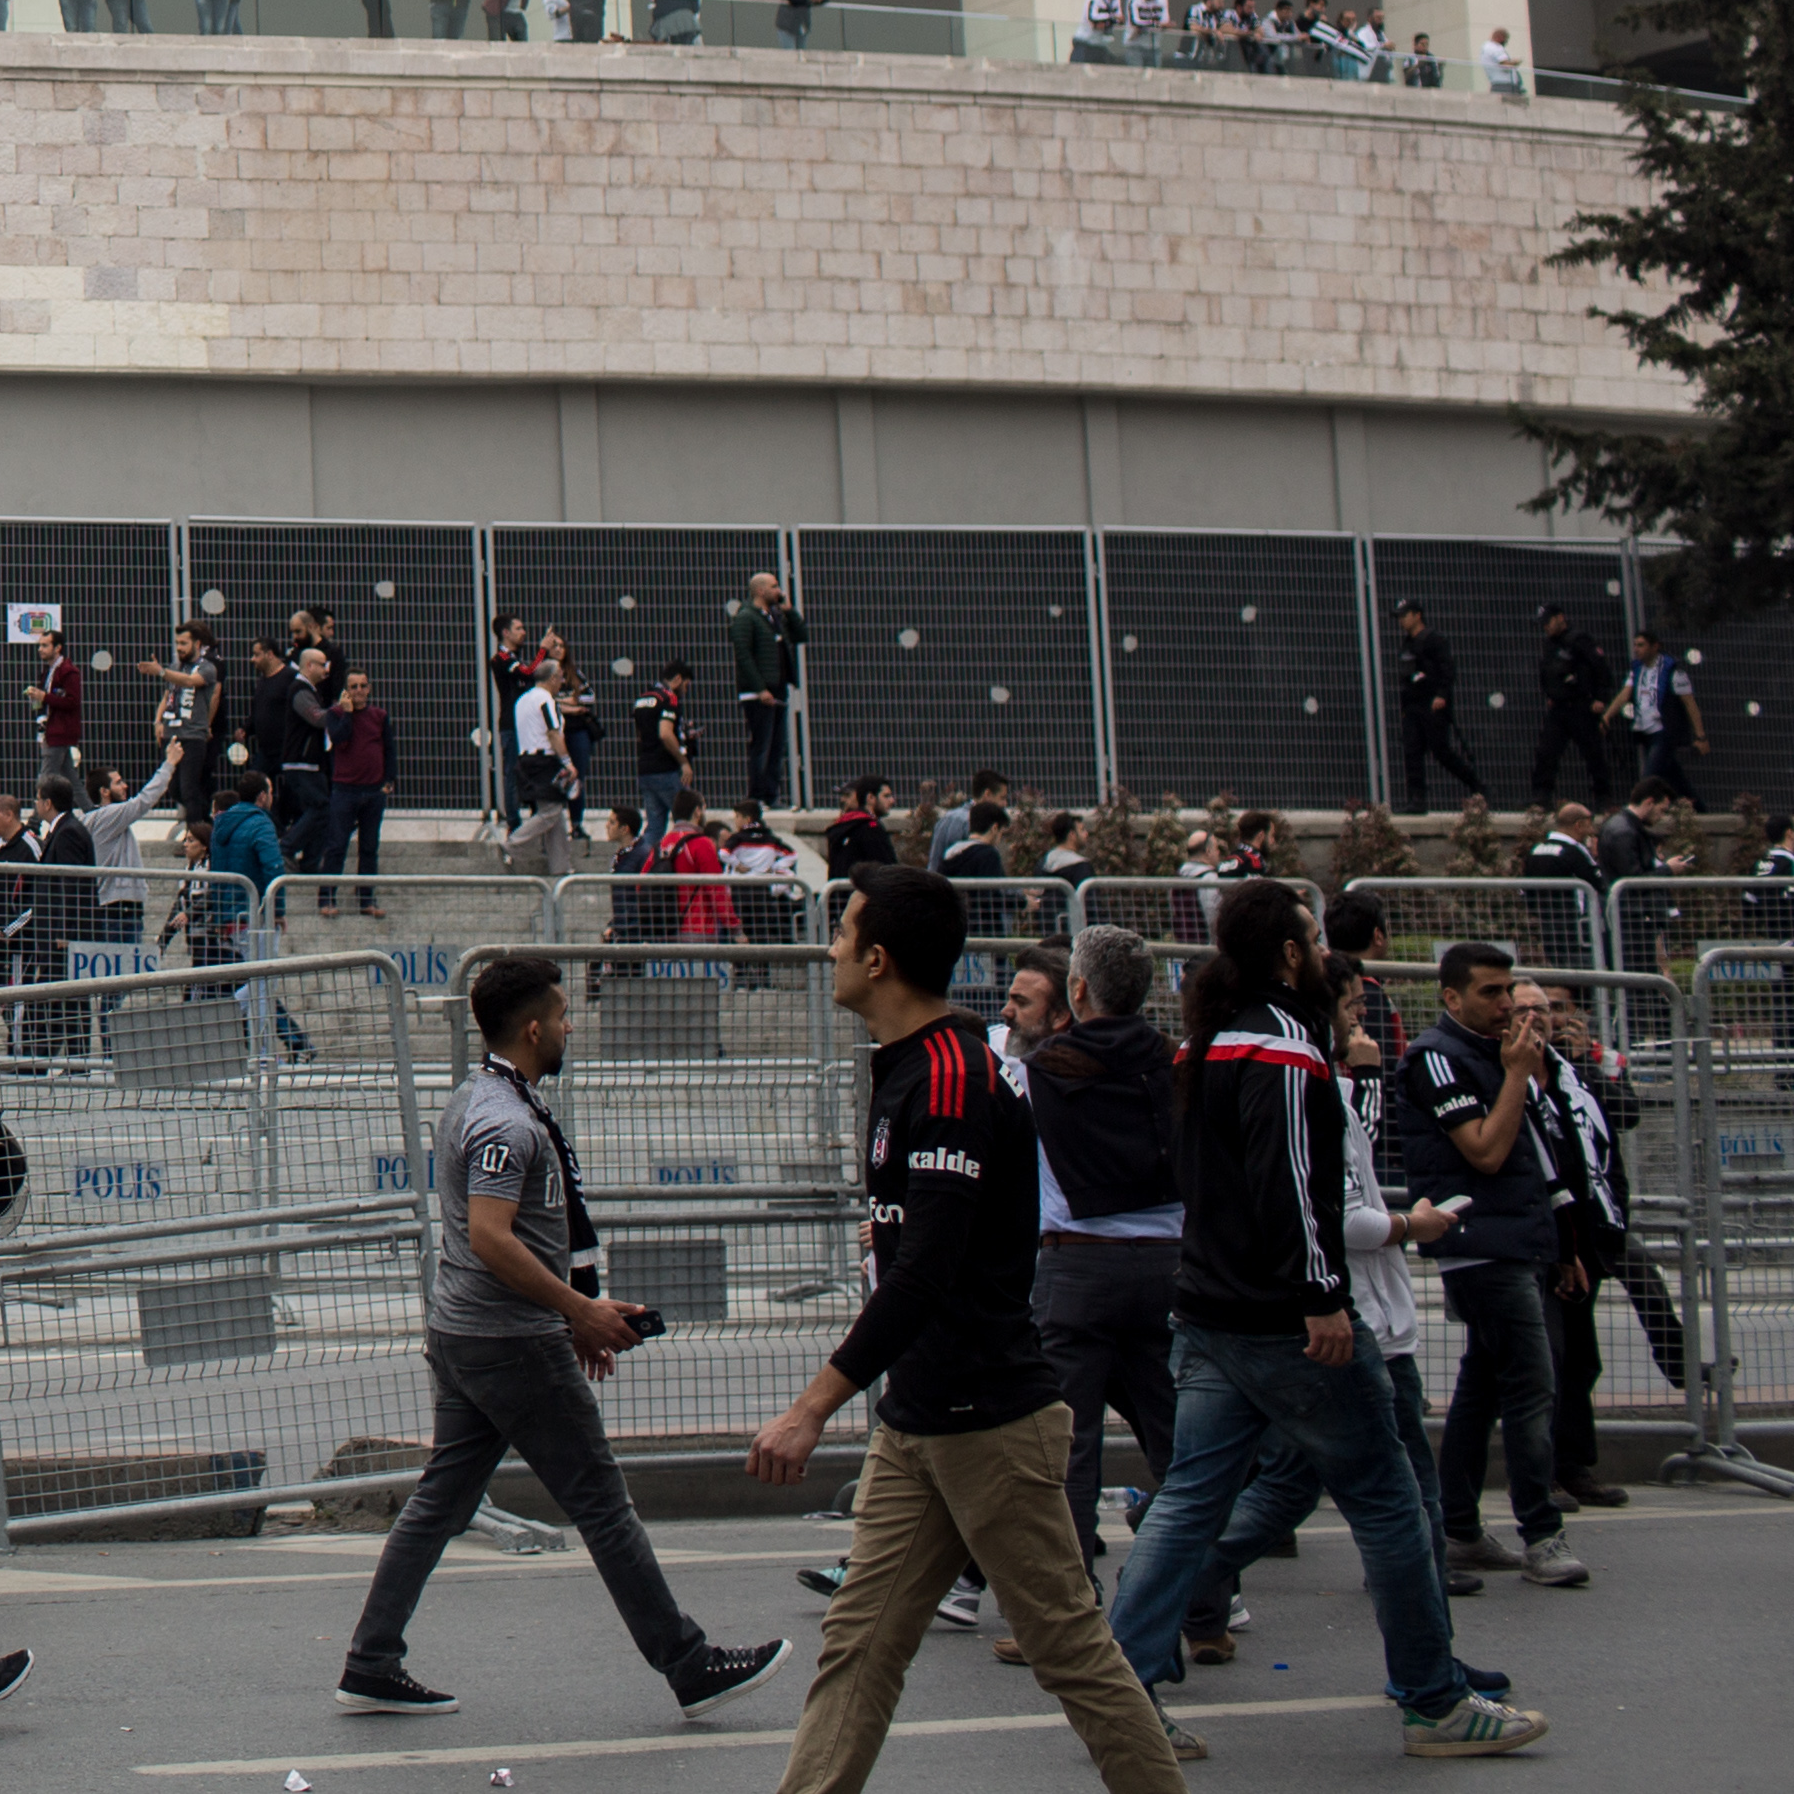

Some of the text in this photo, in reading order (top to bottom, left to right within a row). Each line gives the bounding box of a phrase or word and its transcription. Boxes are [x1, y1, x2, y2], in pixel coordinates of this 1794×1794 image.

[73, 947, 159, 981] POLİS
[1433, 1094, 1479, 1118] kalde
[482, 1144, 510, 1172] 07
[908, 1146, 981, 1179] kalde
[75, 1161, 162, 1200] POLİS
